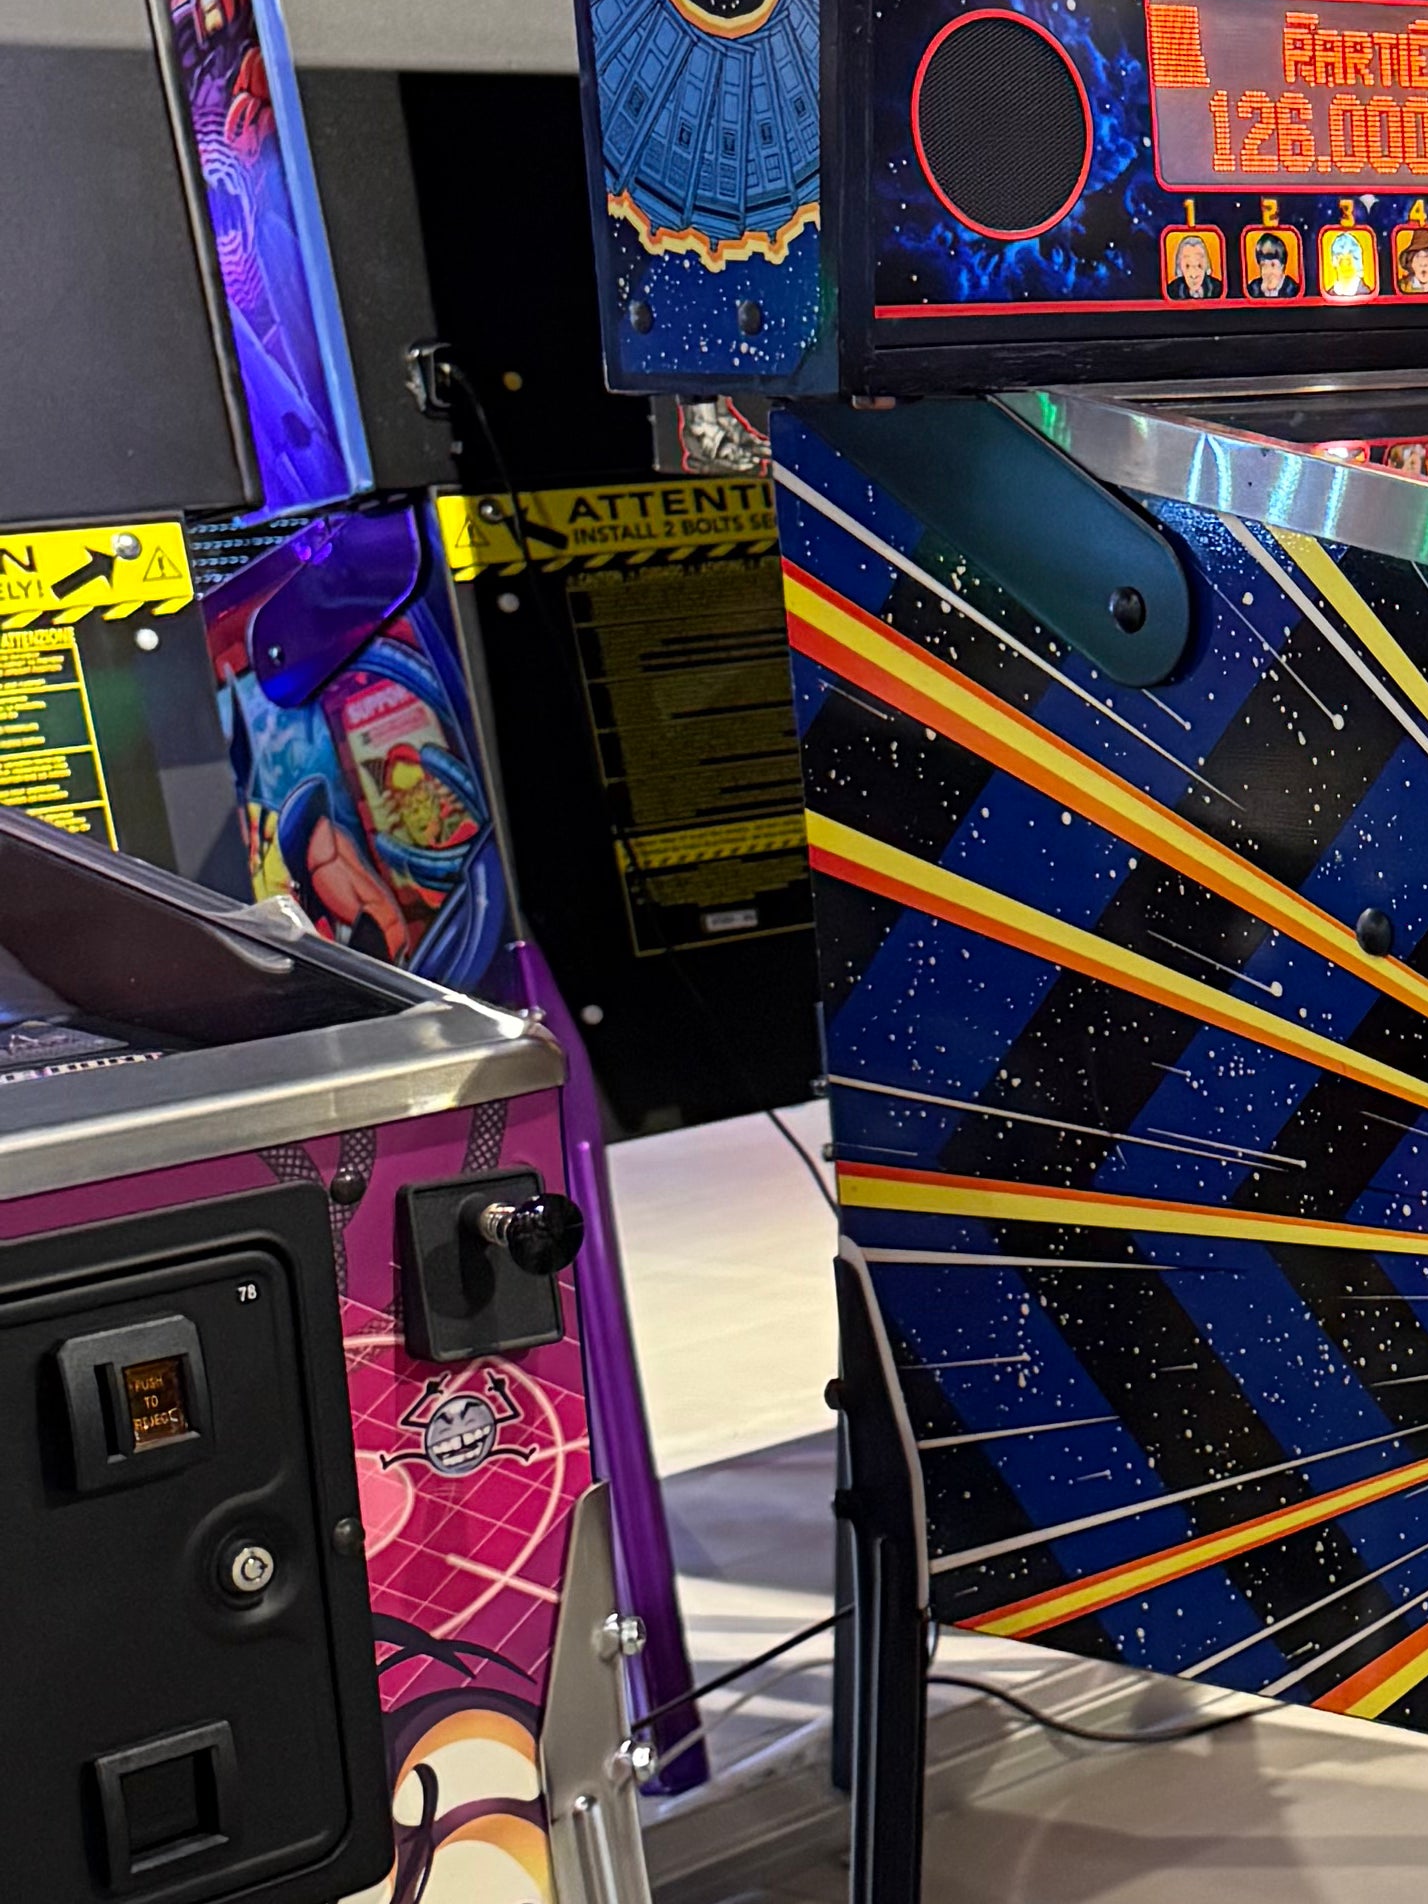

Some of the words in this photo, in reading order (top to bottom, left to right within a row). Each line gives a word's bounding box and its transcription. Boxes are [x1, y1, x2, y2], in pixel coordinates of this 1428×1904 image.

[1183, 198, 1196, 227] 1
[1261, 198, 1280, 227] 2
[1339, 198, 1356, 227] 3
[1409, 198, 1428, 227] 4
[574, 522, 658, 545] INSTALL
[662, 521, 674, 539] 2
[680, 516, 739, 538] BOLTS
[134, 1374, 163, 1393] PUSH
[143, 1395, 159, 1409] TO
